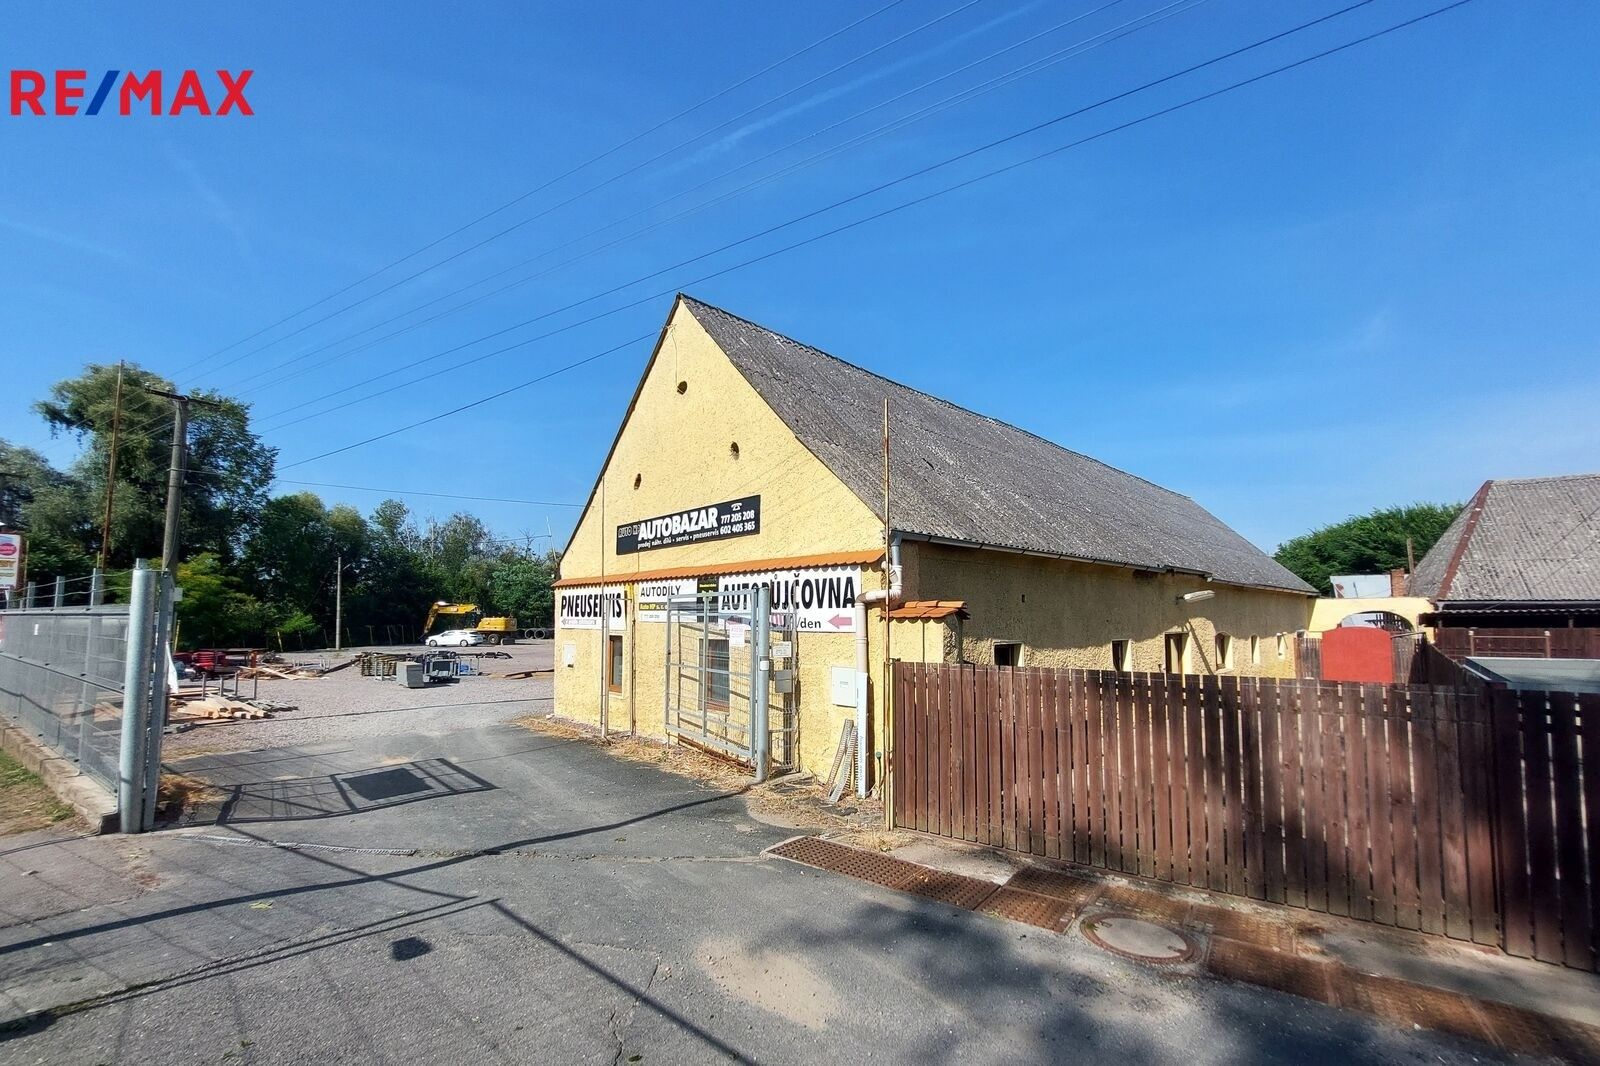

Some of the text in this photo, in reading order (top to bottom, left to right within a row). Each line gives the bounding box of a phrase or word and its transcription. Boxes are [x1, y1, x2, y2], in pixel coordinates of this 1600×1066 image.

[638, 507, 718, 541] AUTOBAZAR
[720, 510, 755, 525] 777 205 208
[720, 521, 755, 535] 602 405 365
[637, 540, 651, 550] prodej
[675, 533, 689, 543] servis
[692, 528, 719, 541] pneuservis
[722, 573, 855, 610] AUTŮJČOVNA
